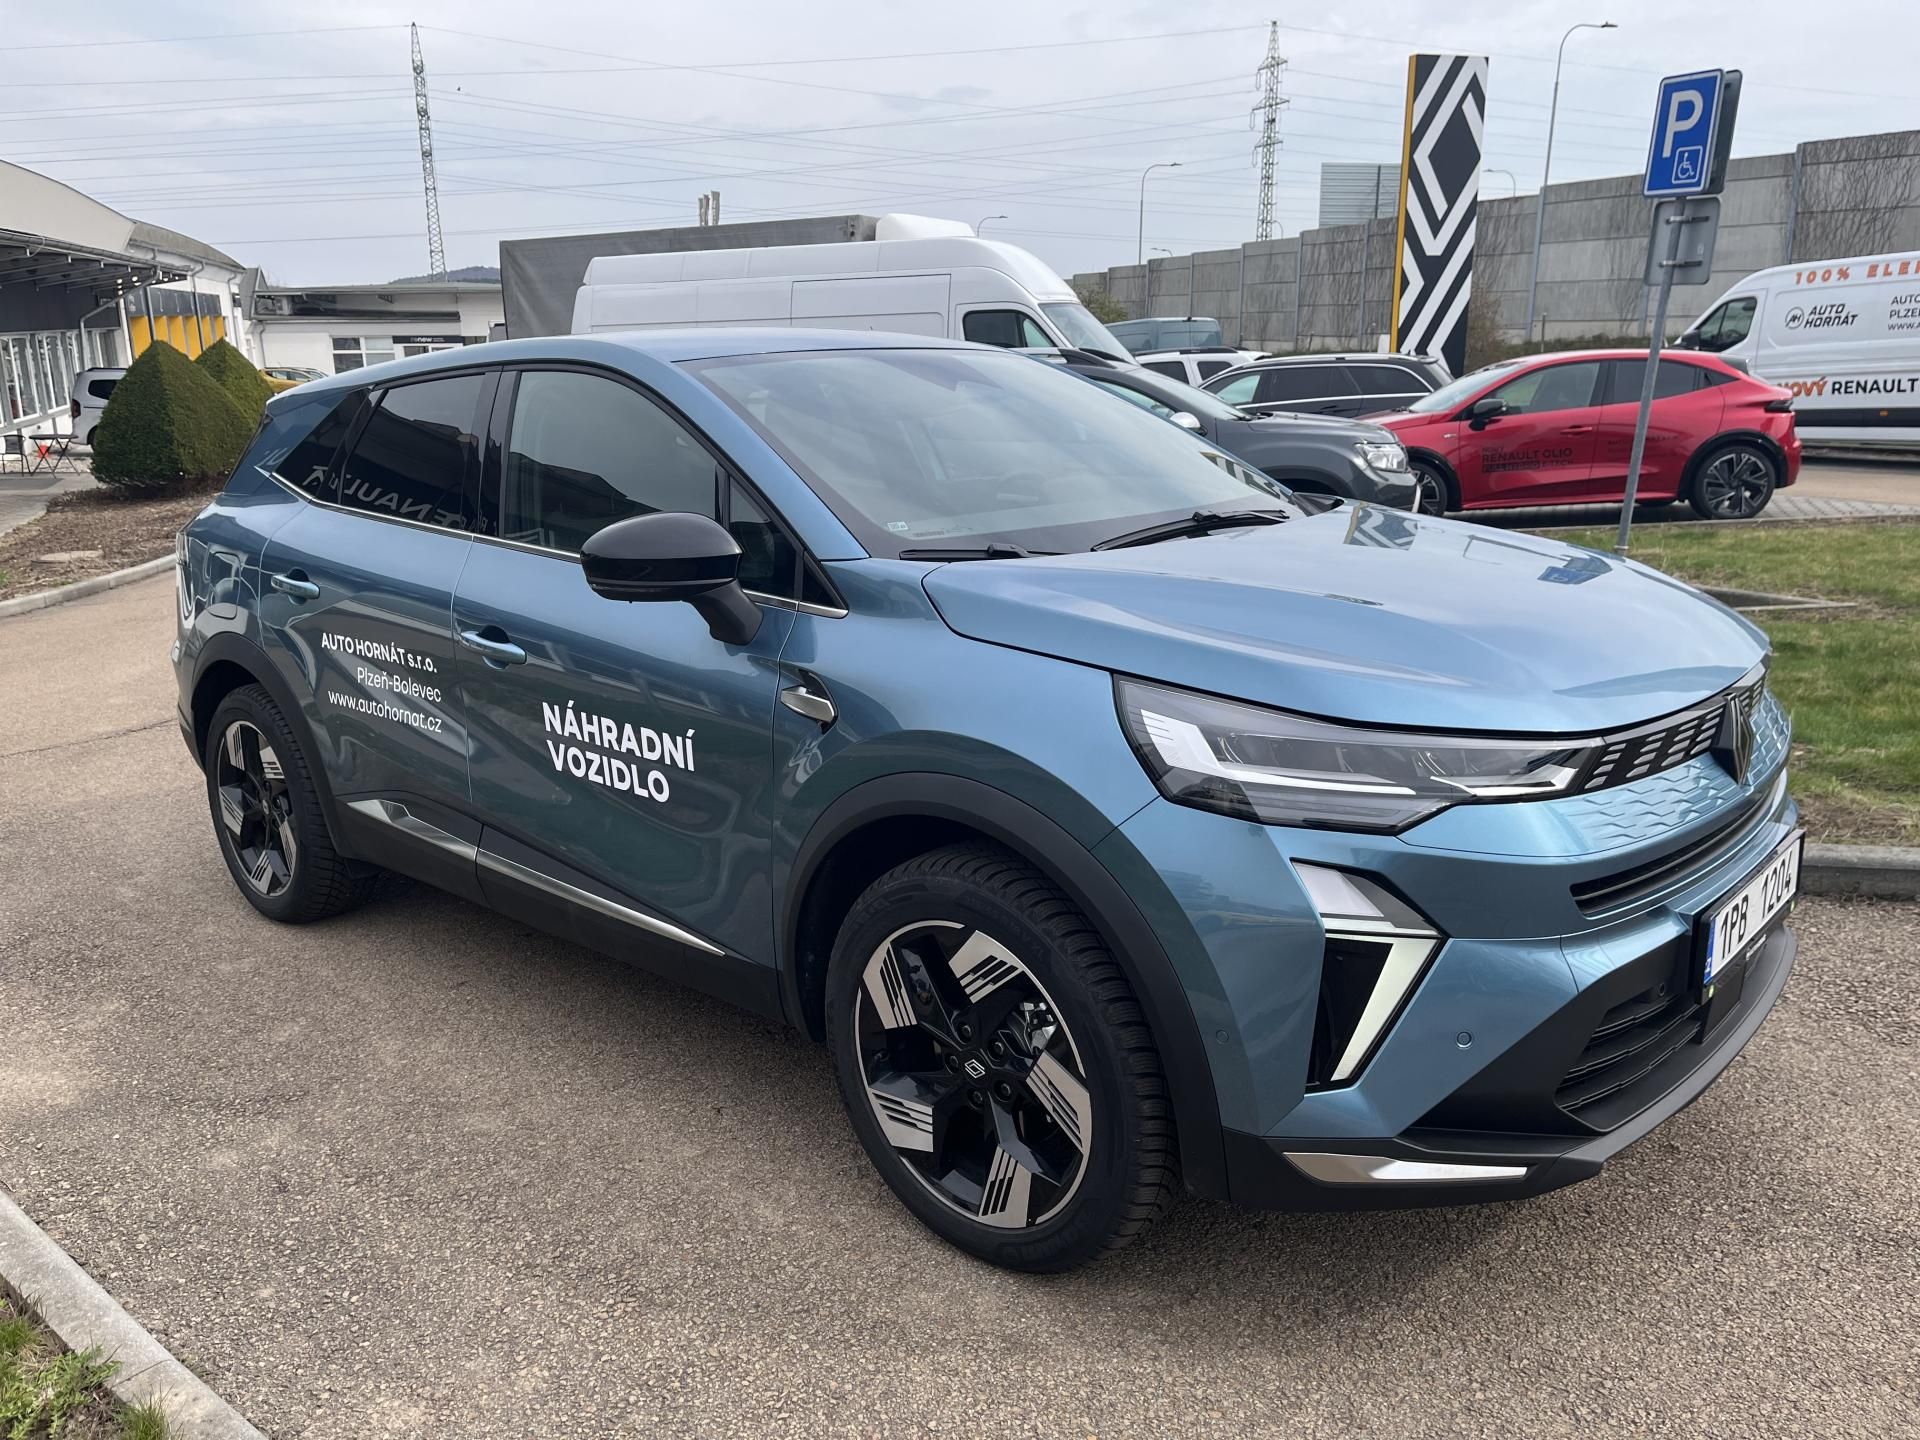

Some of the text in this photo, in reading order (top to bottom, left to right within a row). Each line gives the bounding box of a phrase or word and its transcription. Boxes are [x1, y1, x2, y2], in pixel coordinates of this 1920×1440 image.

[1662, 89, 1704, 158] P
[1795, 266, 1850, 285] 100%
[1804, 311, 1858, 329] HORNÁT
[1808, 303, 1846, 317] AUTO
[1889, 308, 1920, 319] PLZE
[1831, 378, 1919, 395] RENAULT
[321, 632, 438, 673] AUTO HORNÁT s.r.o.
[357, 667, 441, 702] Plzeň-Bolevec
[327, 690, 442, 733] www.autohornat.cz
[542, 700, 695, 772] NÁHRADNÍ
[546, 740, 670, 803] VOZIDLO
[1720, 850, 1793, 960] 1PB 1204
